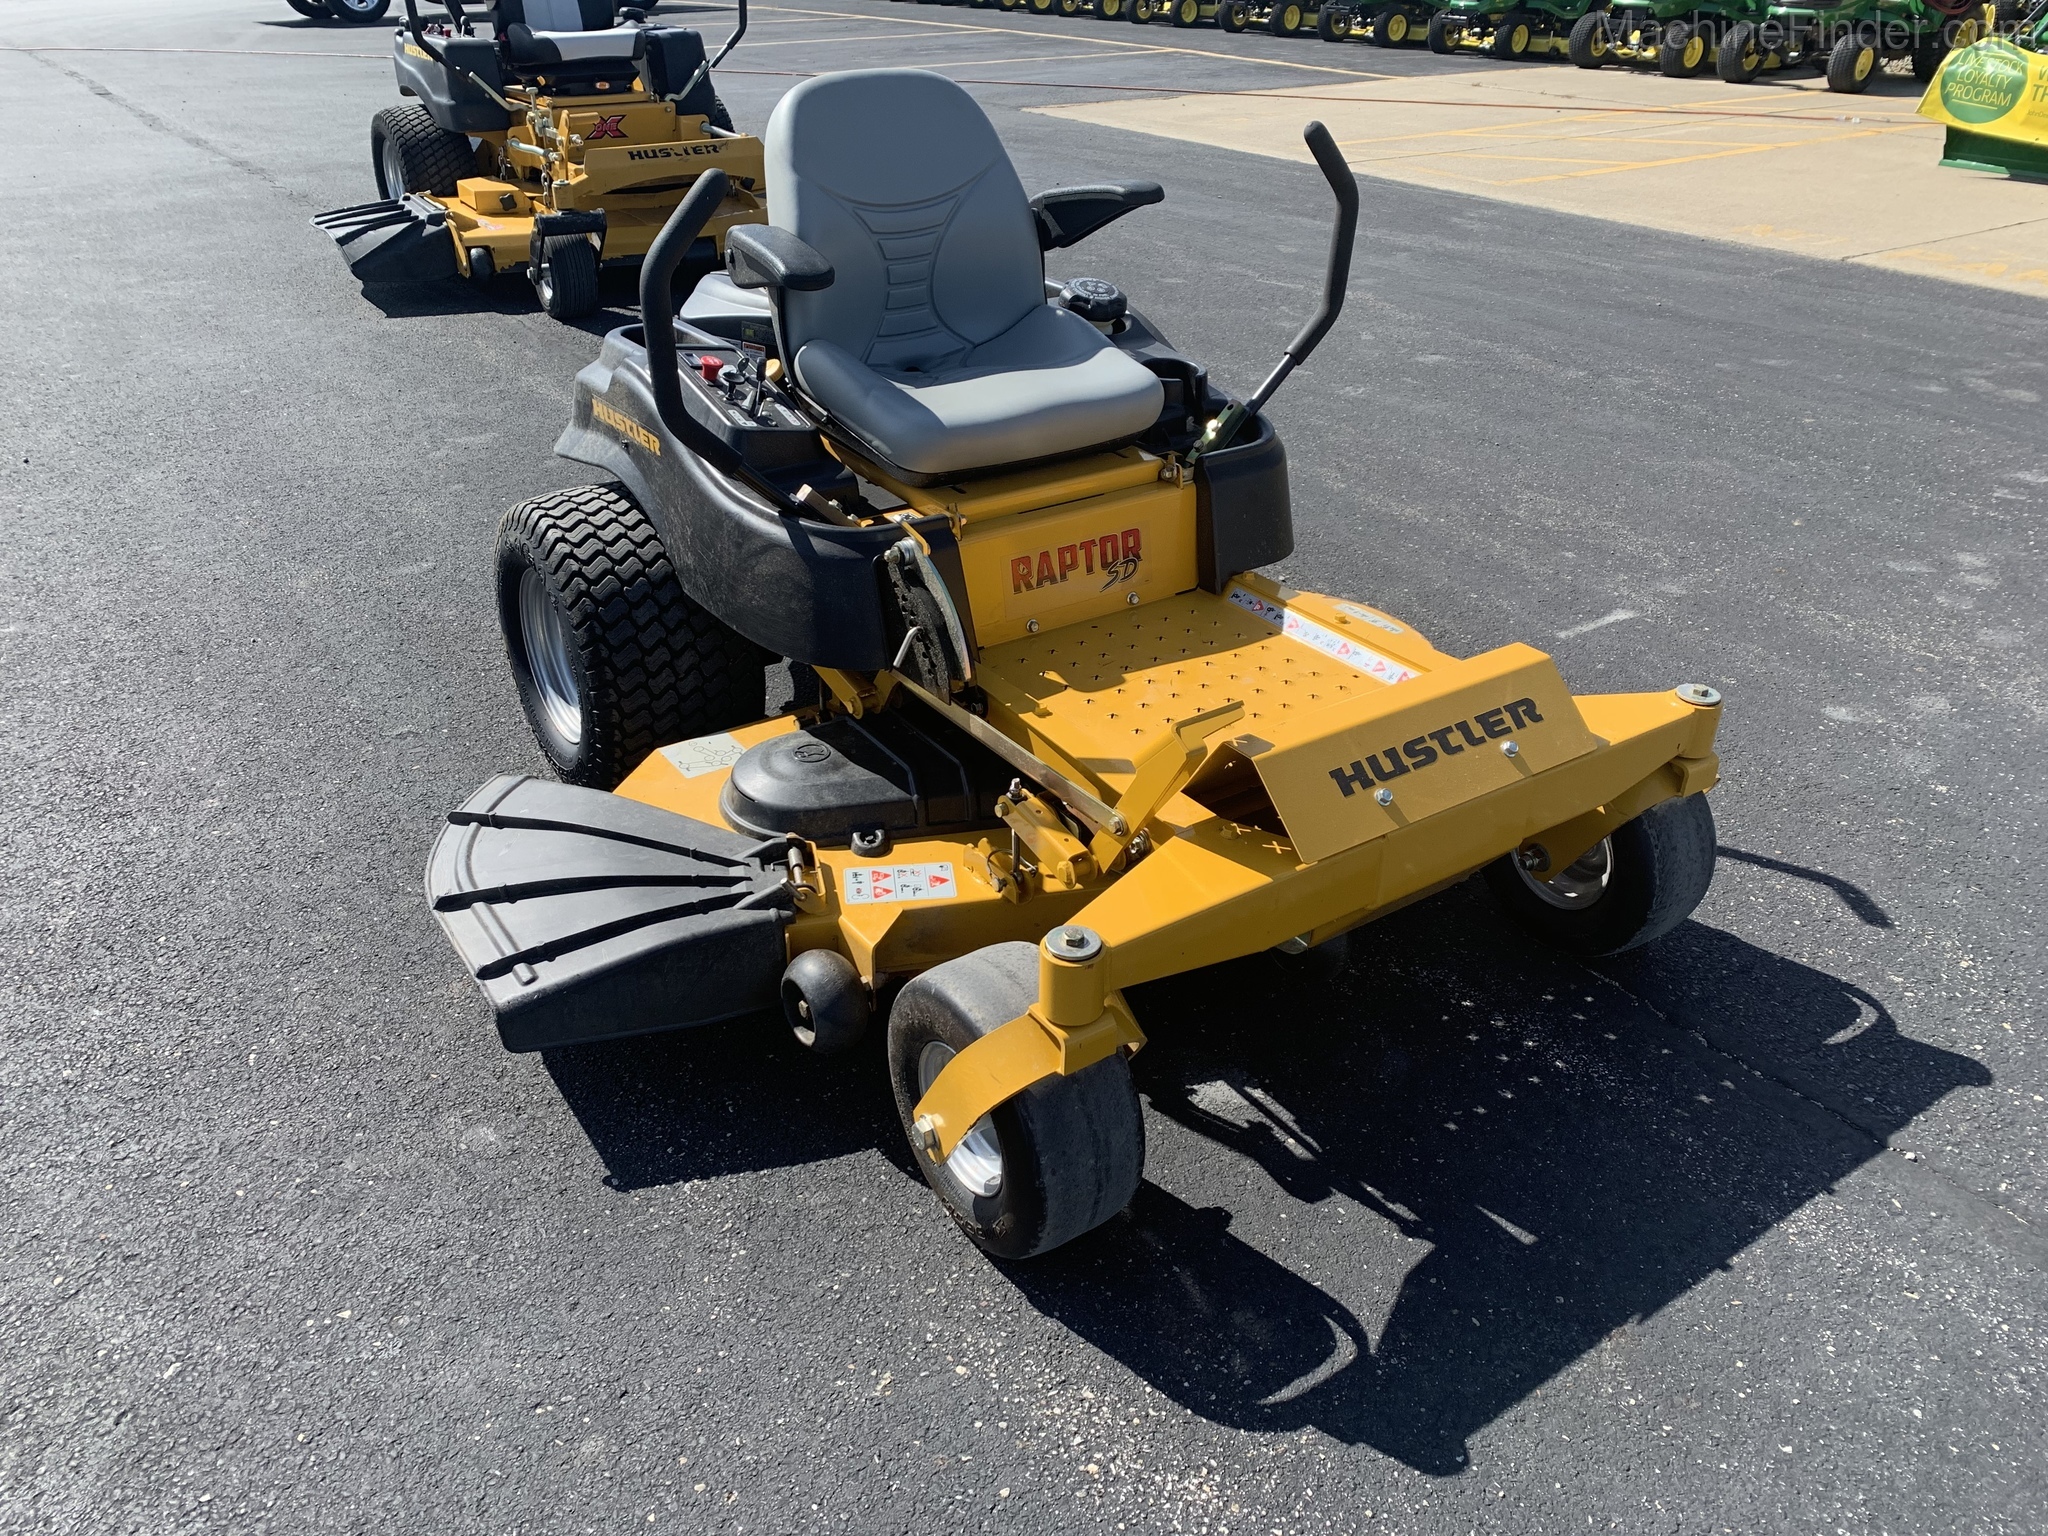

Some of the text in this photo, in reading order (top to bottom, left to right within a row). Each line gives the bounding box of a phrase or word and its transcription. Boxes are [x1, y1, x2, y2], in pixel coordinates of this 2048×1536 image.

[1957, 51, 2024, 75] LIVESTOCK
[1957, 68, 2013, 90] LOYALTY
[1944, 82, 2012, 107] PROGRAM
[591, 398, 662, 457] HUSTLER
[1010, 527, 1143, 595] RAPTOR
[1099, 556, 1140, 593] SD
[1328, 696, 1545, 798] HUSTLER
